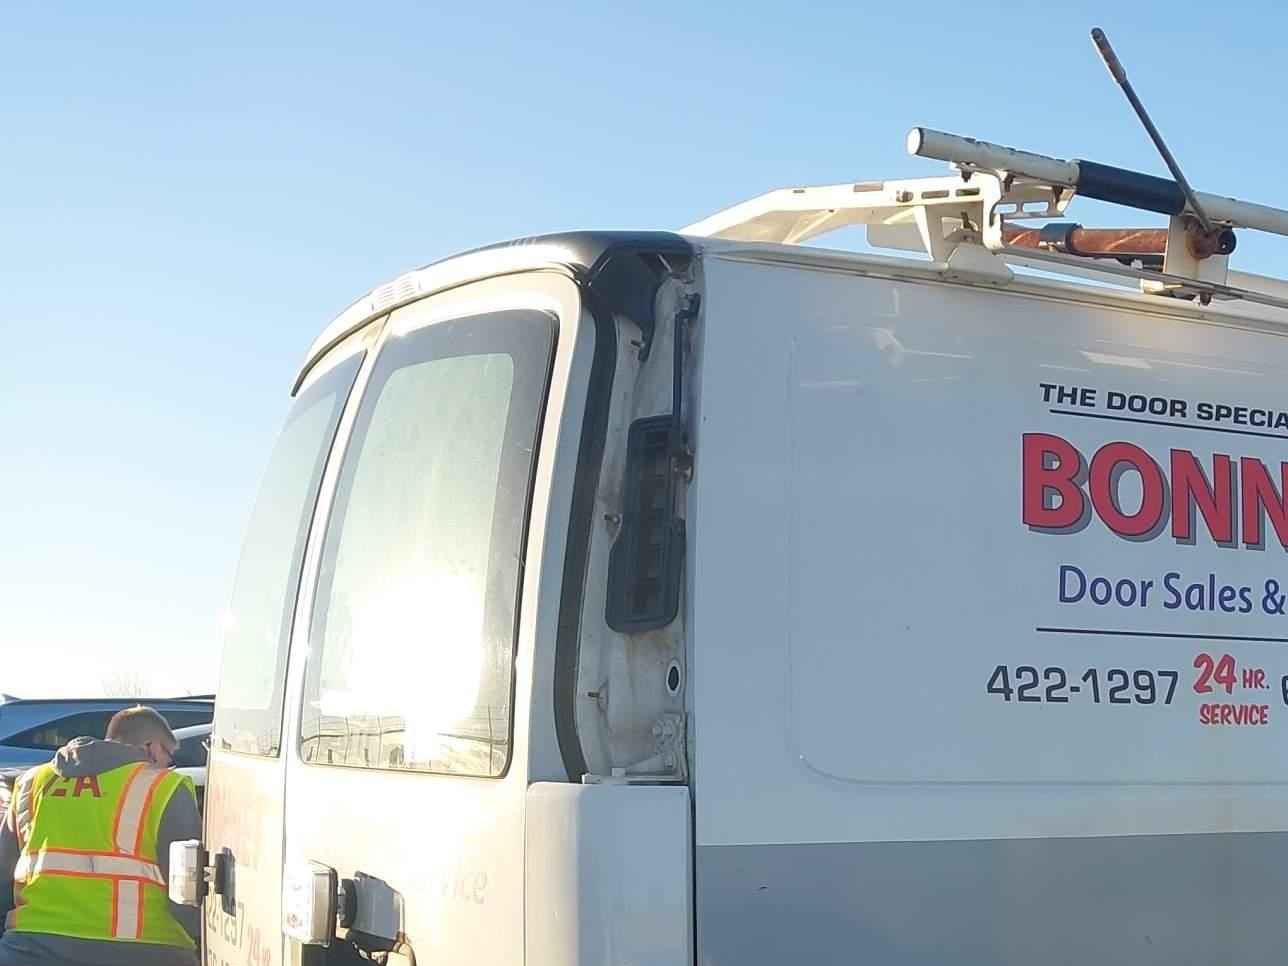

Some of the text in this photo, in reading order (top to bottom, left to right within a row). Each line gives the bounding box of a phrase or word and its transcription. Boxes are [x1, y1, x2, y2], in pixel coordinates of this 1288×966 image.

[1039, 382, 1097, 408] THE
[1106, 391, 1188, 418] DOOR
[1058, 564, 1153, 607] Door
[1163, 572, 1253, 614] Sales
[1262, 578, 1287, 615] &
[986, 665, 1179, 705] 422-1297
[1192, 652, 1270, 695] 24 HR.
[1199, 703, 1270, 726] SERVICE
